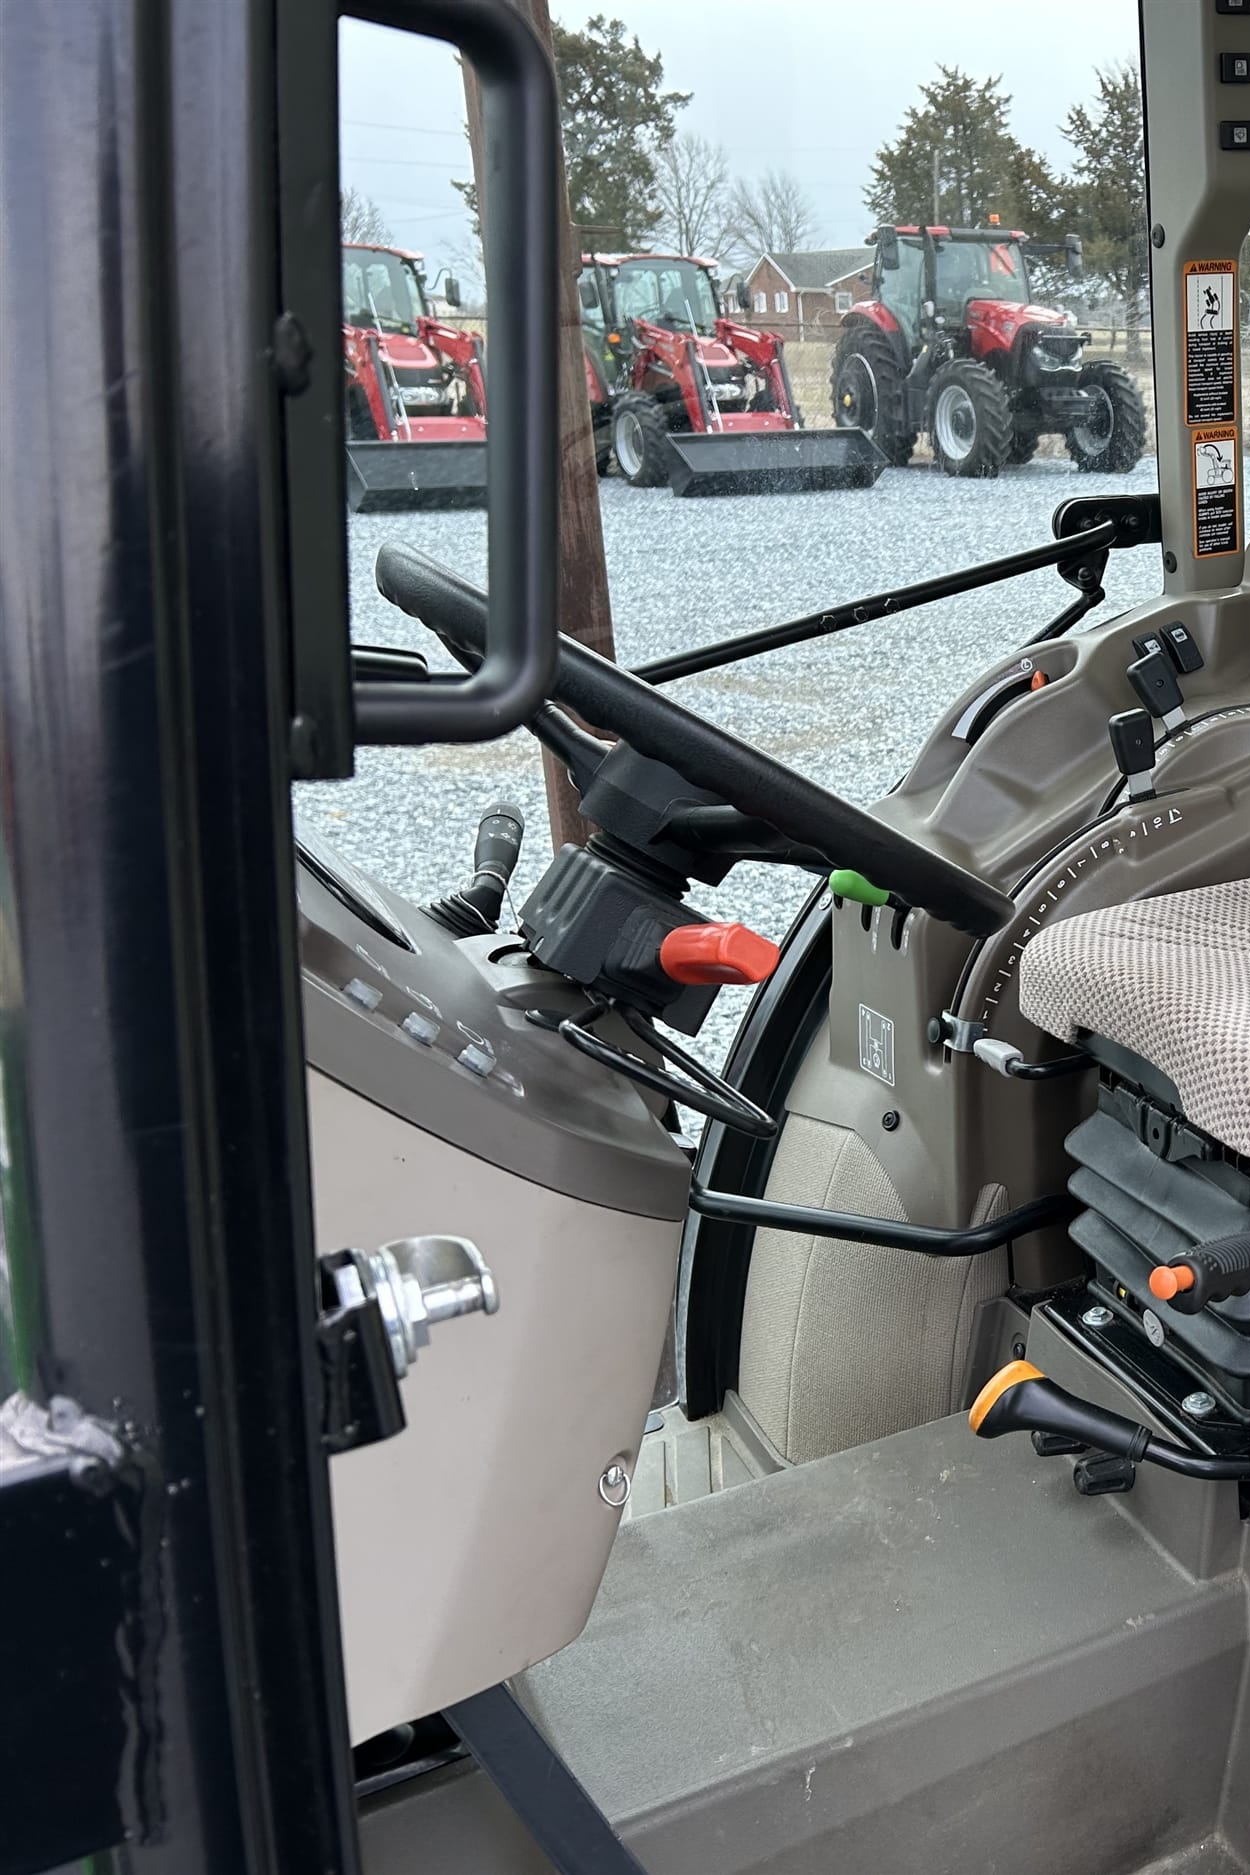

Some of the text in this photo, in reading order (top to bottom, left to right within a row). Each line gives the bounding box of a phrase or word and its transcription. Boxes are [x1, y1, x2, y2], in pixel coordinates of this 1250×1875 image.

[1199, 263, 1232, 272] WARNING
[1203, 429, 1235, 439] WARNING
[1101, 841, 1110, 849] 8
[1038, 904, 1047, 913] 5
[1023, 929, 1031, 938] 4
[1008, 955, 1016, 965] 3
[993, 982, 1002, 992] 2
